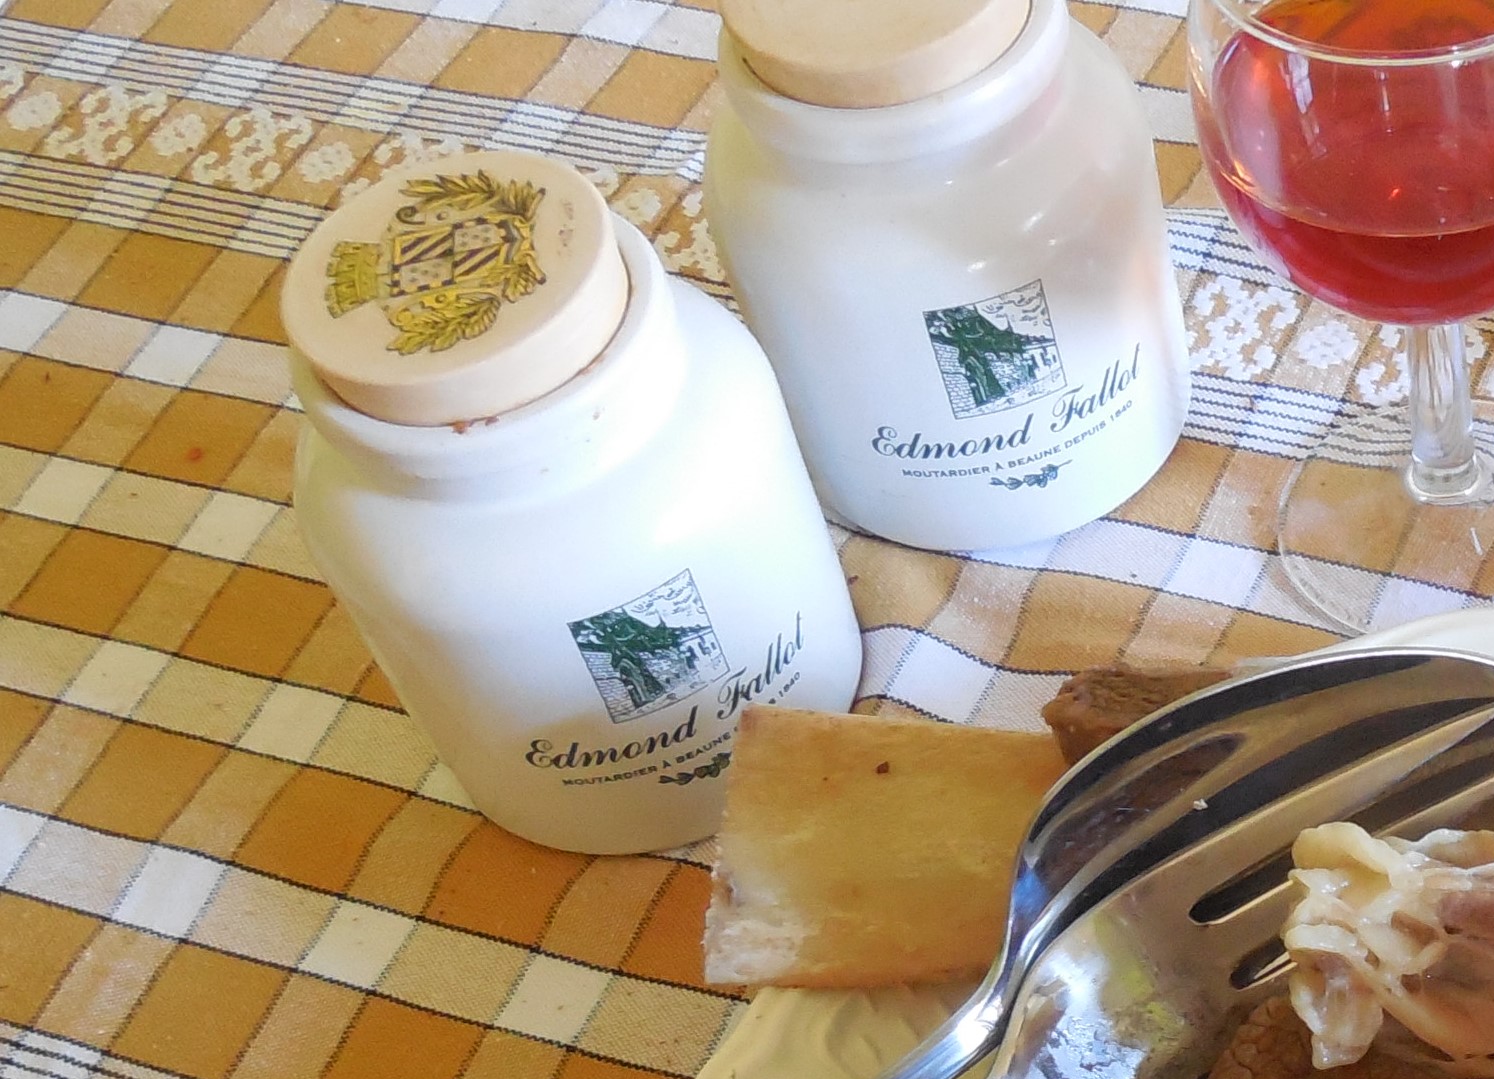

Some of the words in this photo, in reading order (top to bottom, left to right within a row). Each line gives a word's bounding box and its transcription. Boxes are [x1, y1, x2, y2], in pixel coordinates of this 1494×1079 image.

[872, 413, 1034, 460] Edmond
[1050, 342, 1140, 433] Fallot
[902, 465, 991, 478] MOUTARDIER
[1008, 445, 1061, 468] BEAUNE
[1064, 420, 1106, 449] DEPUIS
[1110, 399, 1133, 421] 1840
[525, 705, 699, 769] Edmond
[716, 610, 804, 720] Fallot
[562, 765, 658, 786] MOUTARDIER
[675, 732, 731, 764] BEAUNE
[778, 671, 800, 698] 1840
